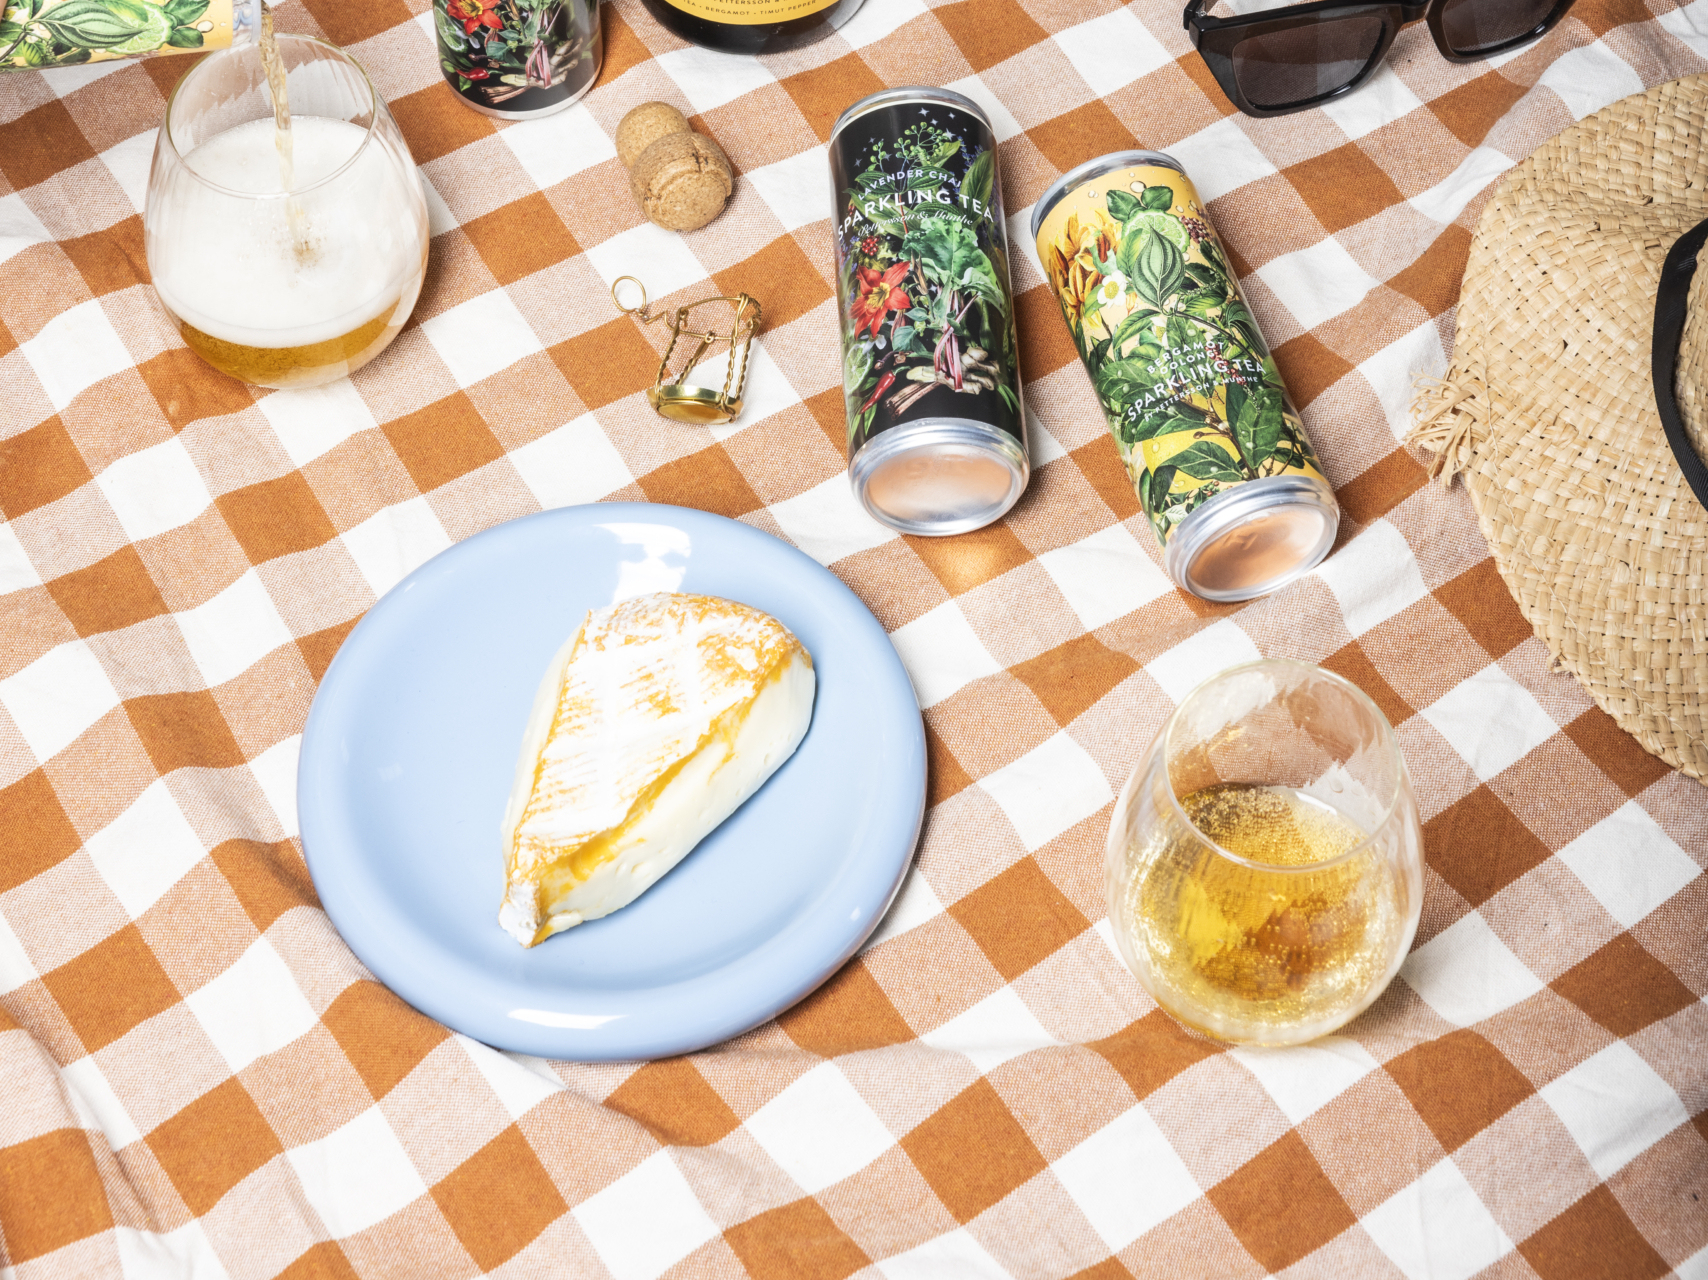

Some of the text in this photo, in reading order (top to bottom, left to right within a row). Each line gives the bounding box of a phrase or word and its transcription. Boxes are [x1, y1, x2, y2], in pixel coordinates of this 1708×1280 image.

[705, 6, 750, 16] BERGAMOT
[858, 169, 962, 201] LAVENDER CHAI
[838, 190, 994, 241] SPARKLING TEA
[1147, 340, 1224, 374] BERGAMOT
[1159, 349, 1215, 375] OOLONG
[1127, 358, 1267, 422] SPARKLING TEA
[1144, 411, 1154, 422] BY
[1155, 382, 1210, 413] PETTERSSON
[1222, 375, 1259, 385] MUNTHE
